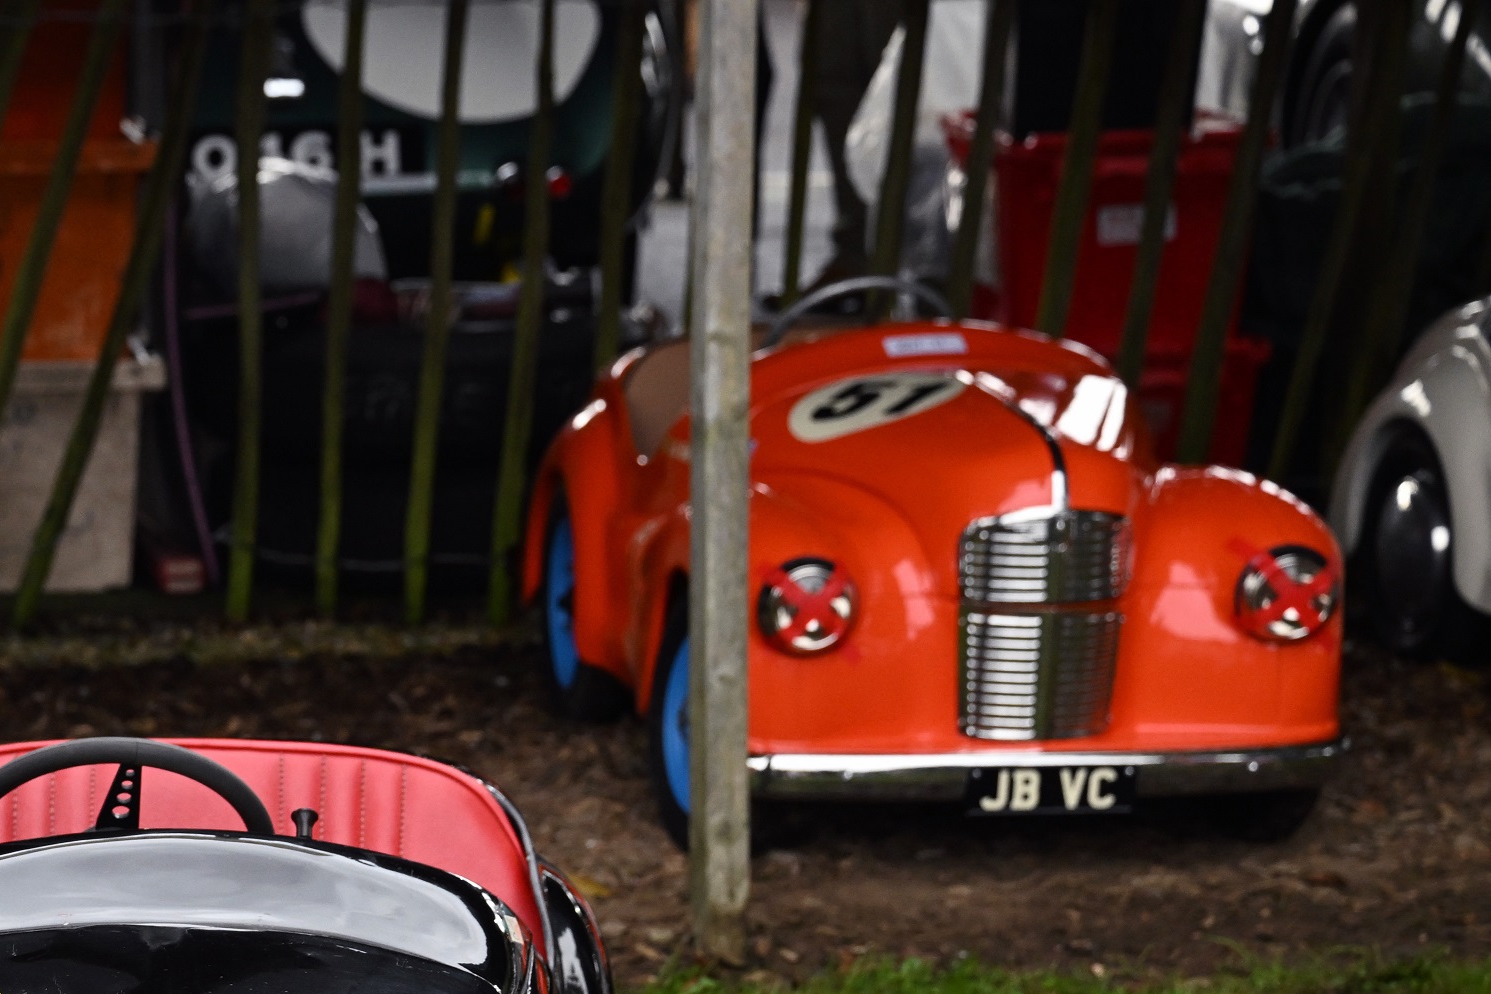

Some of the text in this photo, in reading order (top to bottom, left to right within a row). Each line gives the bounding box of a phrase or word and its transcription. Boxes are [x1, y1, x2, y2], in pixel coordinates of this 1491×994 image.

[813, 381, 950, 420] 51
[979, 767, 1118, 812] JB VC
